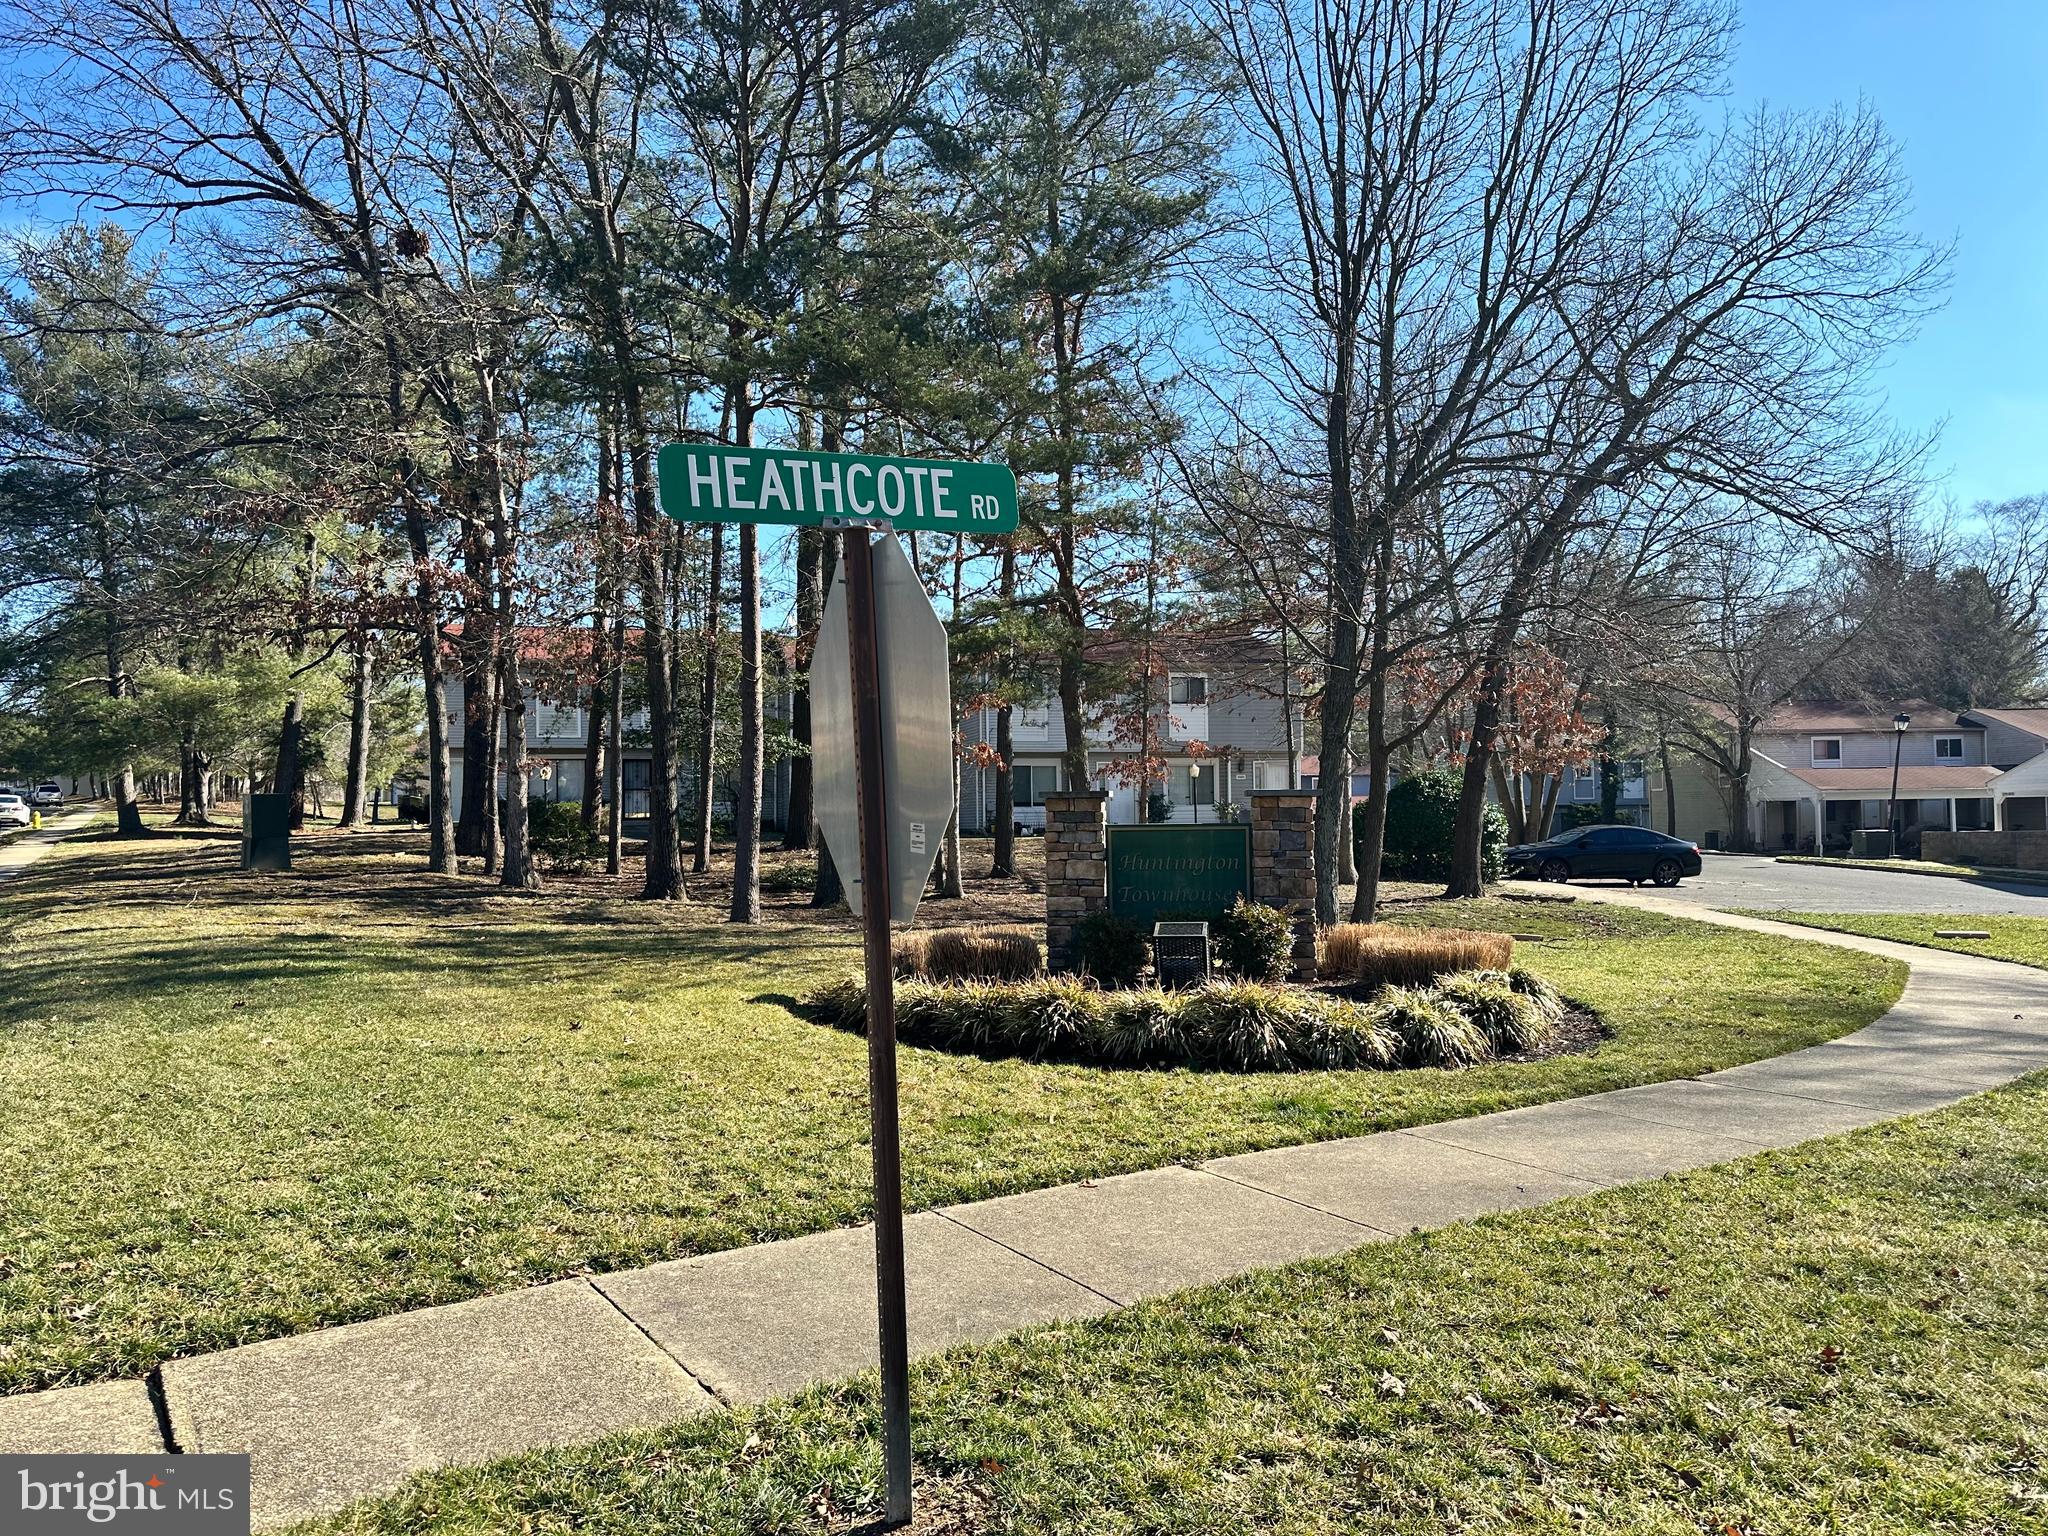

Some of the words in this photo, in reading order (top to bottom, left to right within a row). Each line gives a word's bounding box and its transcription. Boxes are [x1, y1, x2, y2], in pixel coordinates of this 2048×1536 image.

[687, 454, 958, 518] HEATHCOTE
[970, 494, 1000, 520] RD
[1118, 852, 1240, 876] Huntington
